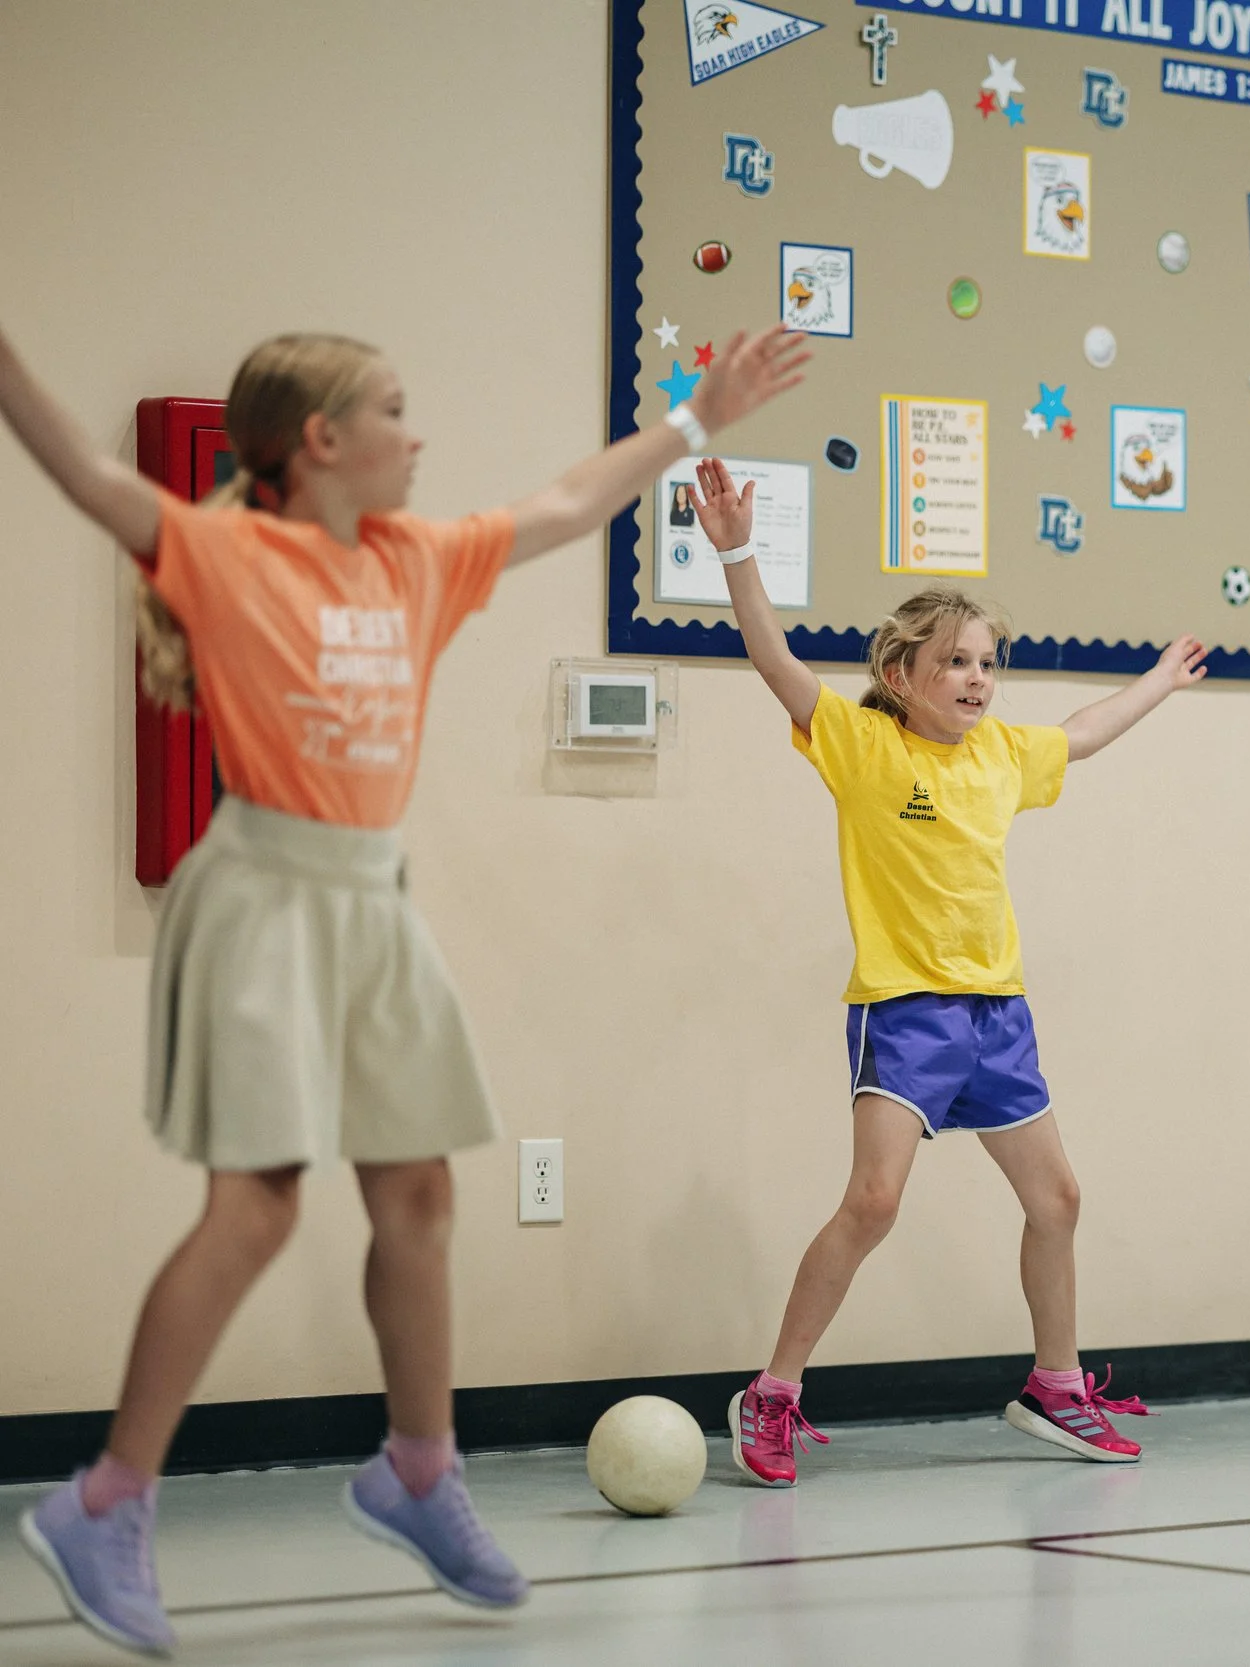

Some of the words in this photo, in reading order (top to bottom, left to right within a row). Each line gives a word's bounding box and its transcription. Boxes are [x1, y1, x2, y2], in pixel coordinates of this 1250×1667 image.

[1101, 0, 1172, 40] ALL
[695, 53, 727, 78] SOAR
[727, 40, 757, 64] HIGH
[756, 20, 802, 50] EAGLES
[1164, 62, 1227, 96] JAMES
[942, 408, 957, 420] TO
[899, 811, 937, 822] Christian
[907, 802, 934, 812] Desert
